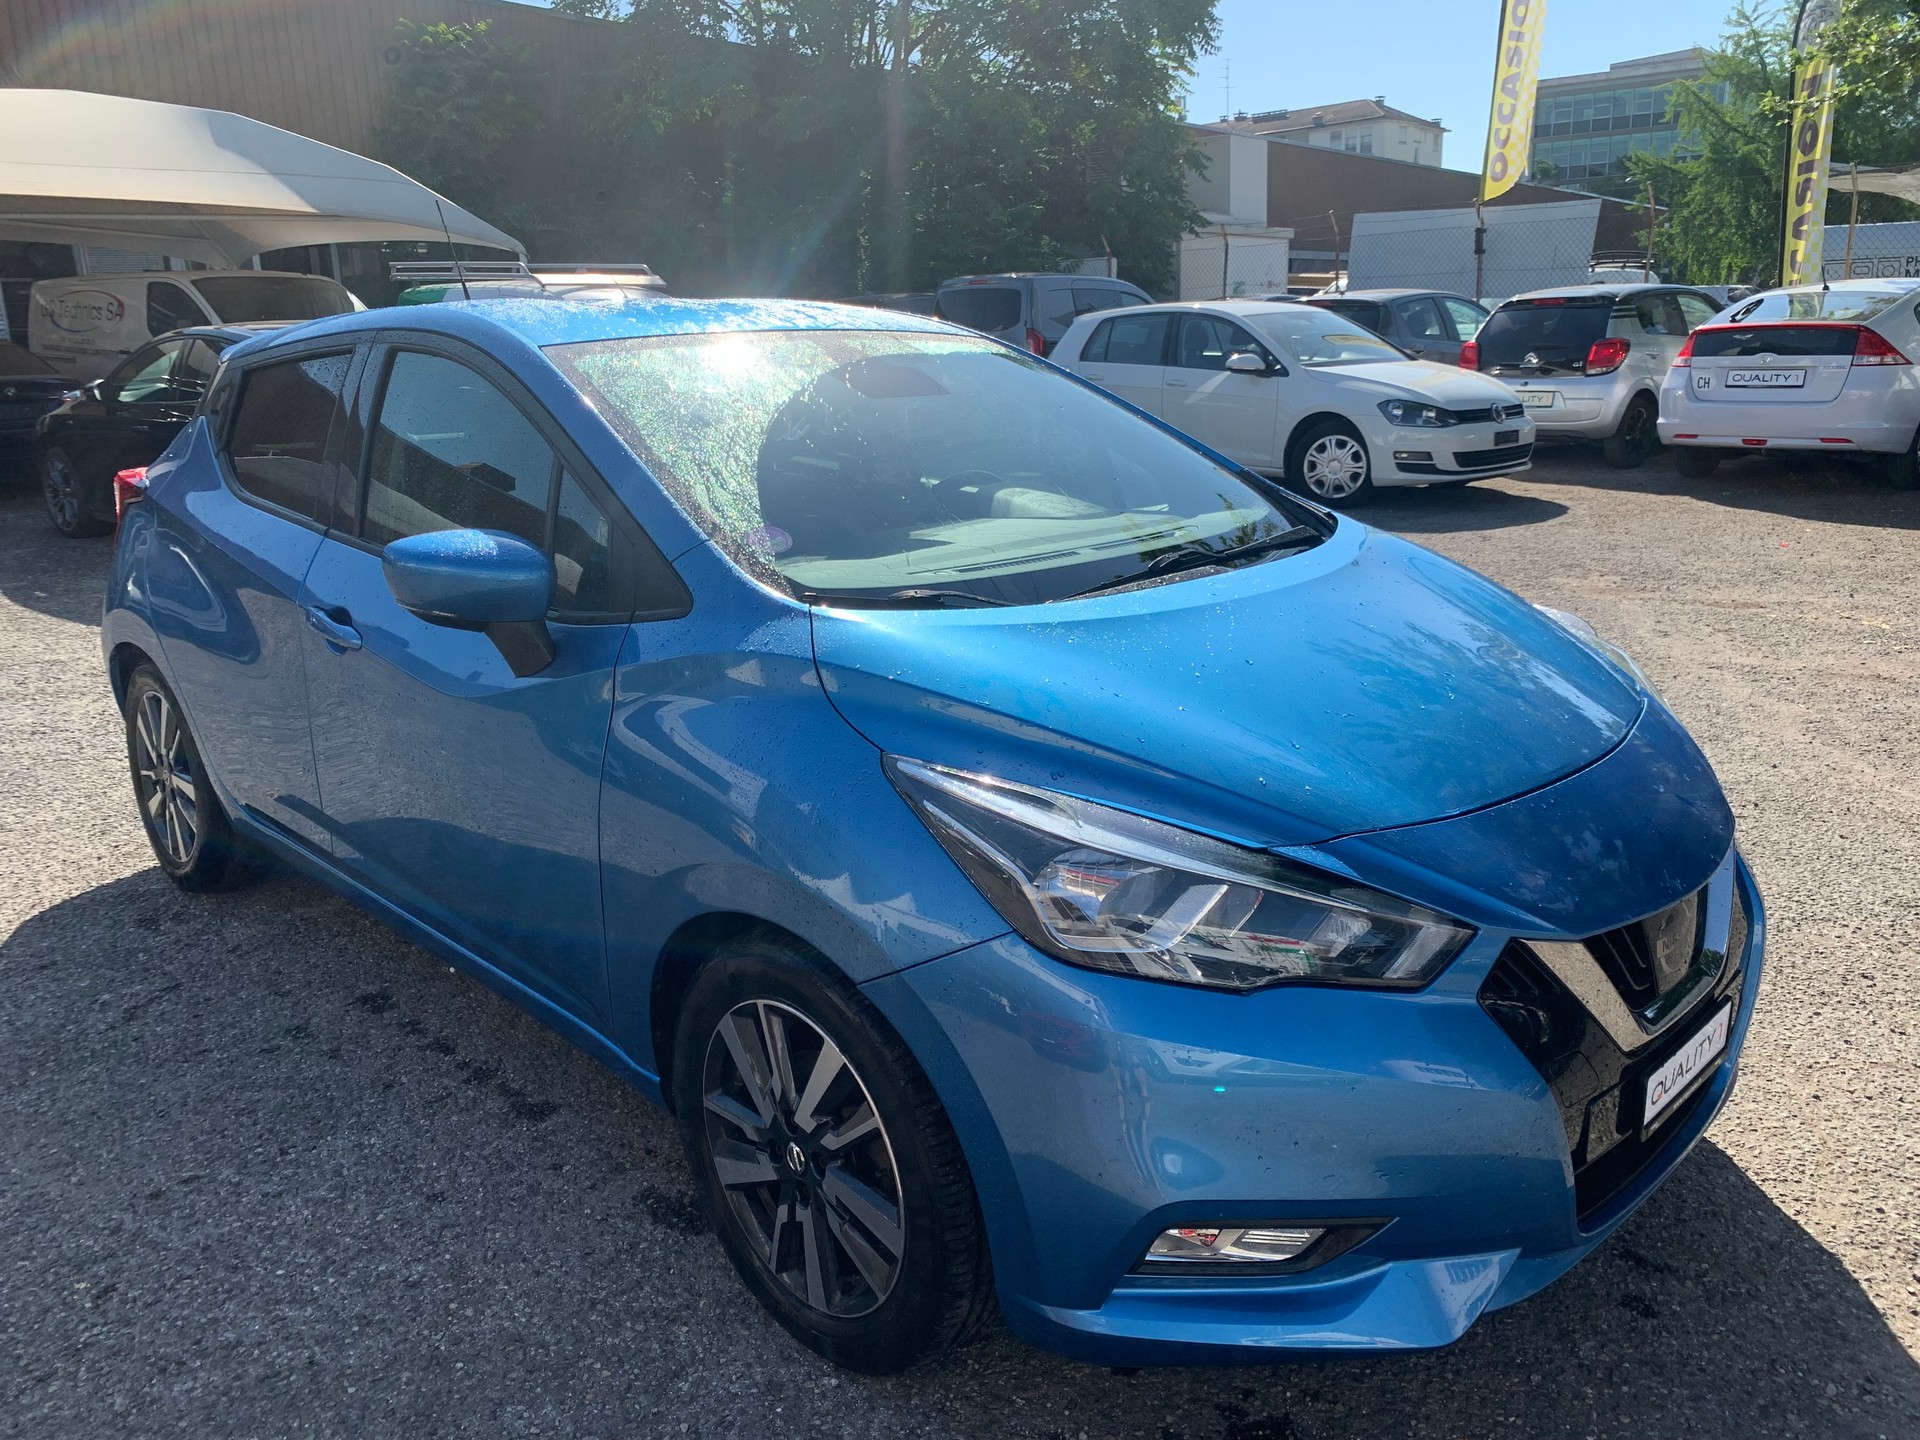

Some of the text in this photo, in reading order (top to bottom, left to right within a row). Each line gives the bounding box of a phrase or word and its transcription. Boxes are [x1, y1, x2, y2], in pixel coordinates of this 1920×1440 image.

[1490, 0, 1530, 183] OCCASIO
[1697, 377, 1711, 389] CH
[1732, 374, 1792, 383] QUALITY
[1651, 1028, 1717, 1106] QUALITY
